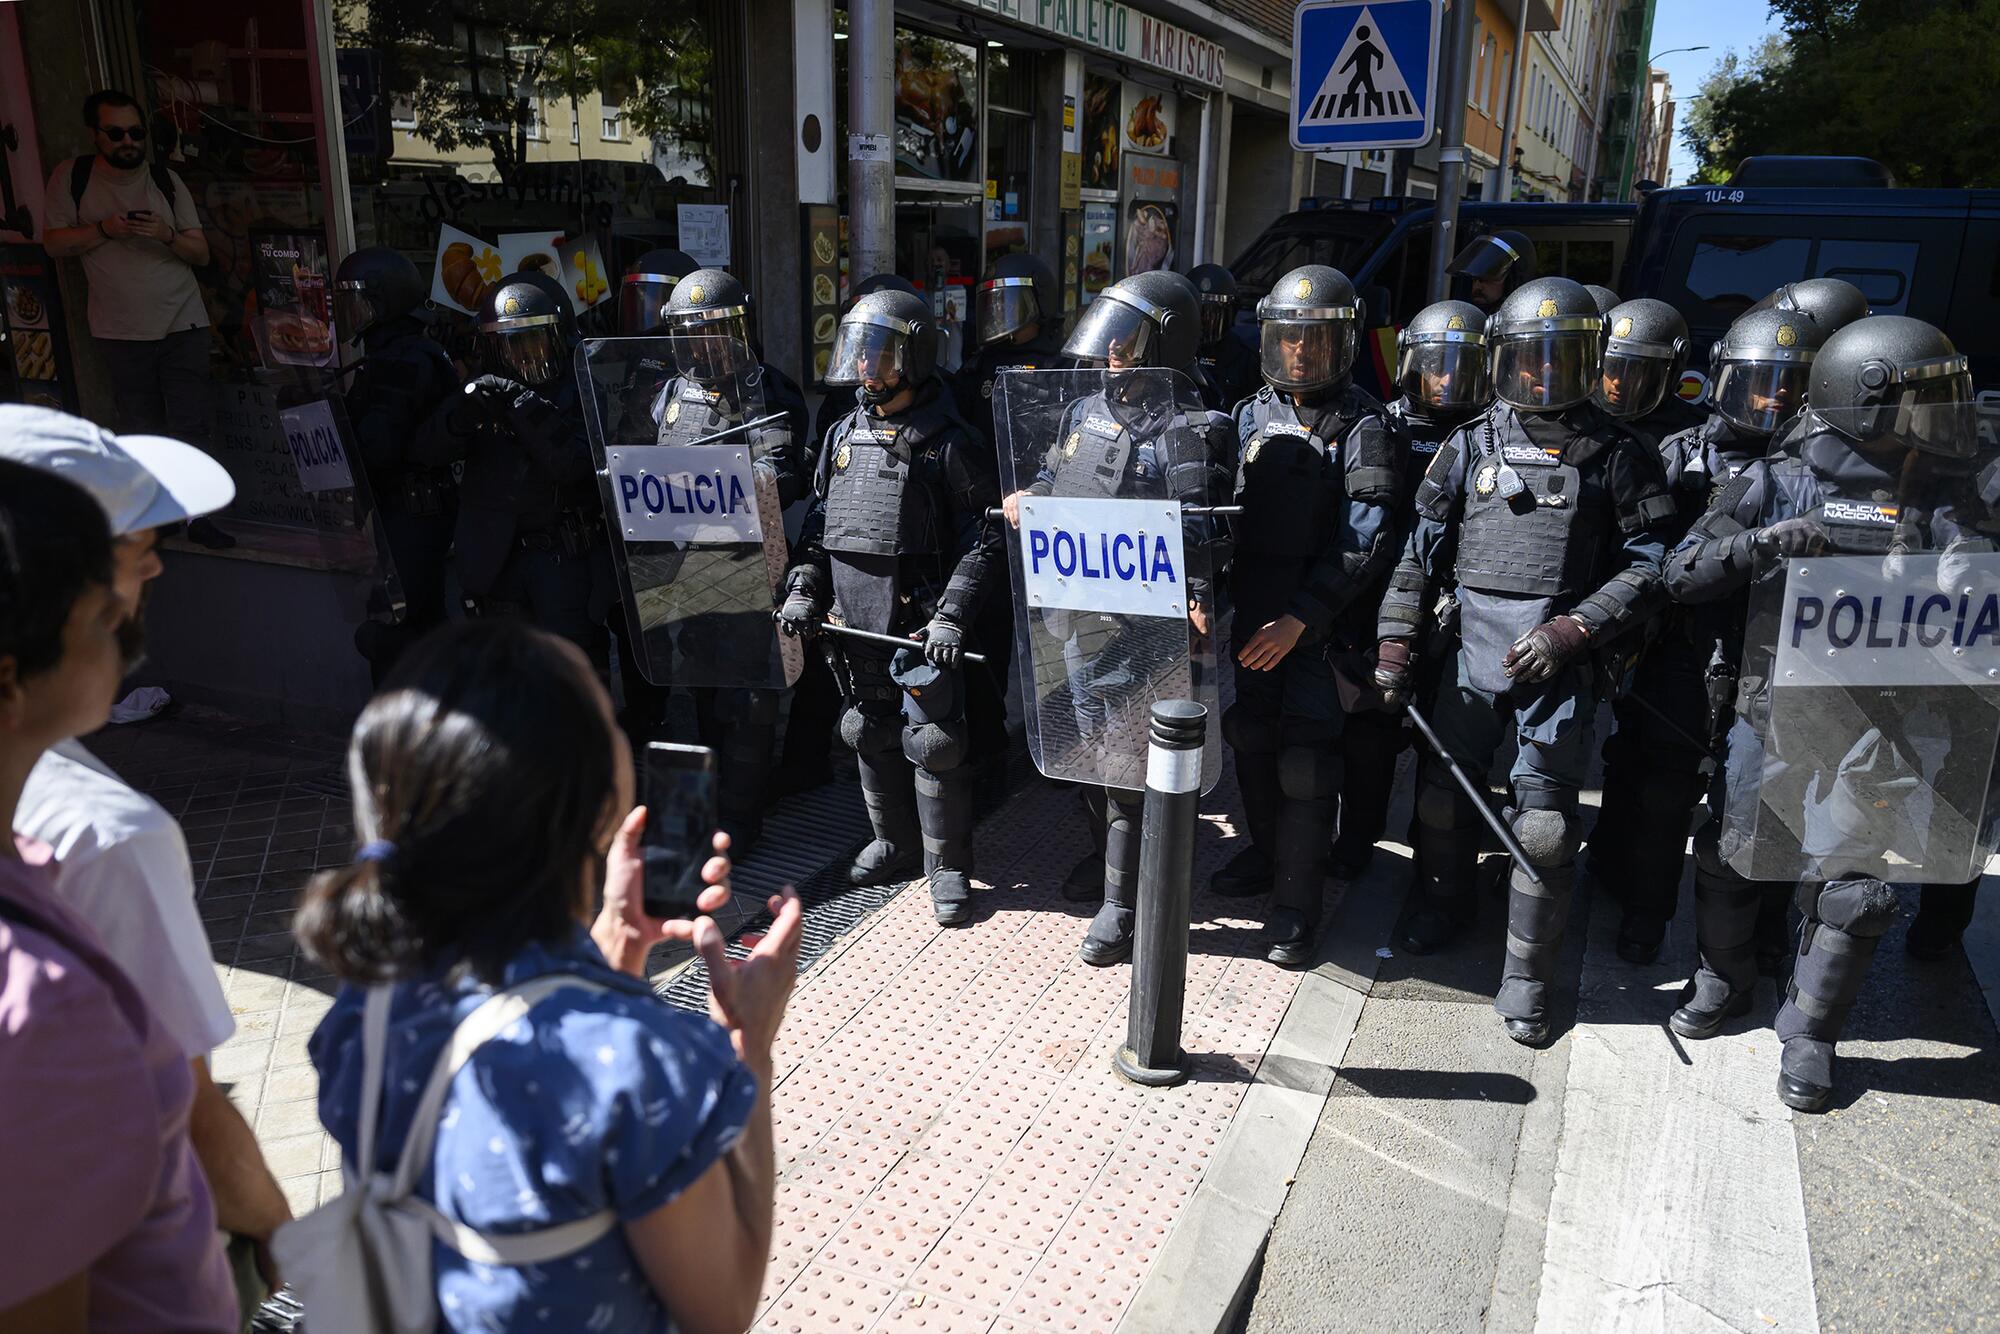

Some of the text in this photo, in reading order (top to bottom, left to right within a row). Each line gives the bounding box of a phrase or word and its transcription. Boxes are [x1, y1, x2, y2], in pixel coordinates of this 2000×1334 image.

[1040, 0, 1225, 86] PALETO MARISCOS
[262, 249, 300, 259] TU COMBO
[1267, 422, 1300, 430] POLICIA
[1264, 427, 1308, 439] NACIONAL
[1411, 440, 1440, 448] OLICI
[1824, 502, 1882, 514] POLICIA
[1823, 510, 1896, 523] NACIONAL
